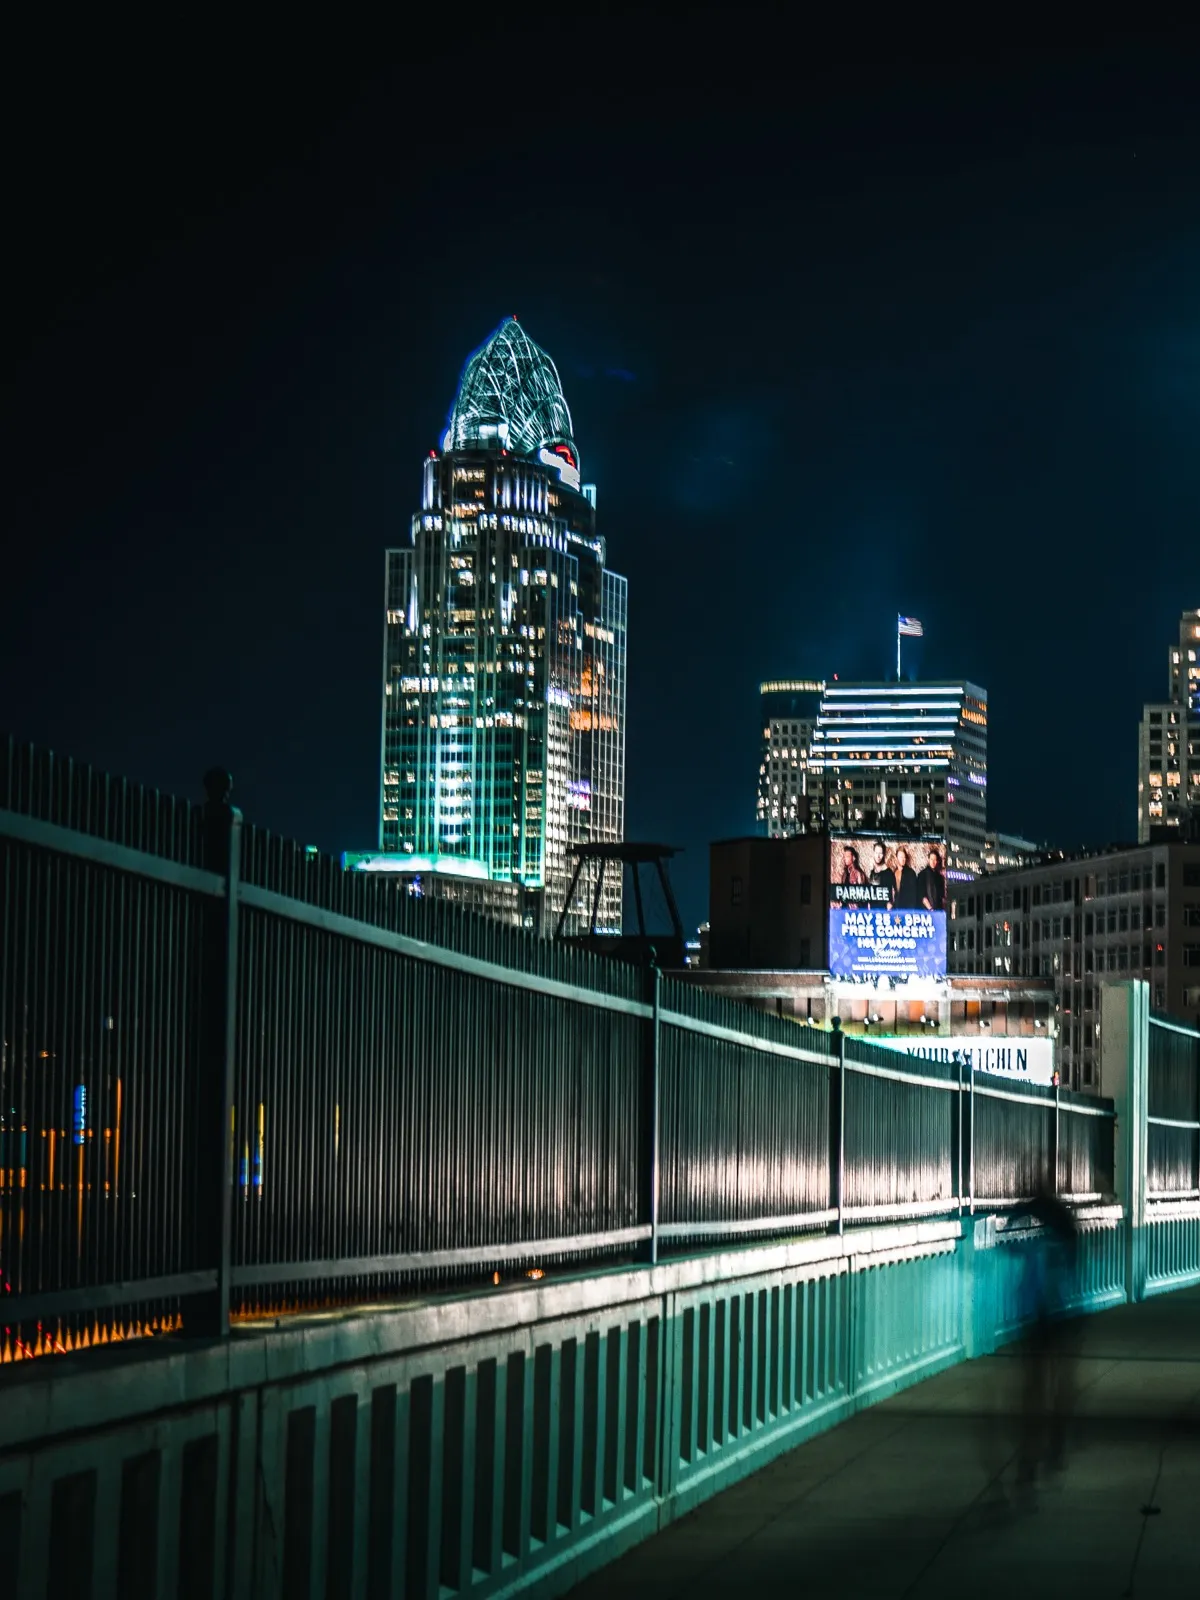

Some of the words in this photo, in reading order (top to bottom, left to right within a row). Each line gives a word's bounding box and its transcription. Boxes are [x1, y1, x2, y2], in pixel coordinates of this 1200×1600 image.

[835, 886, 889, 901] PARMALEE
[845, 912, 873, 925] MAY
[904, 913, 933, 927] 9PM
[841, 924, 874, 936] FREE
[875, 925, 935, 938] CONCERT
[857, 937, 917, 949] HOLLYWOOD
